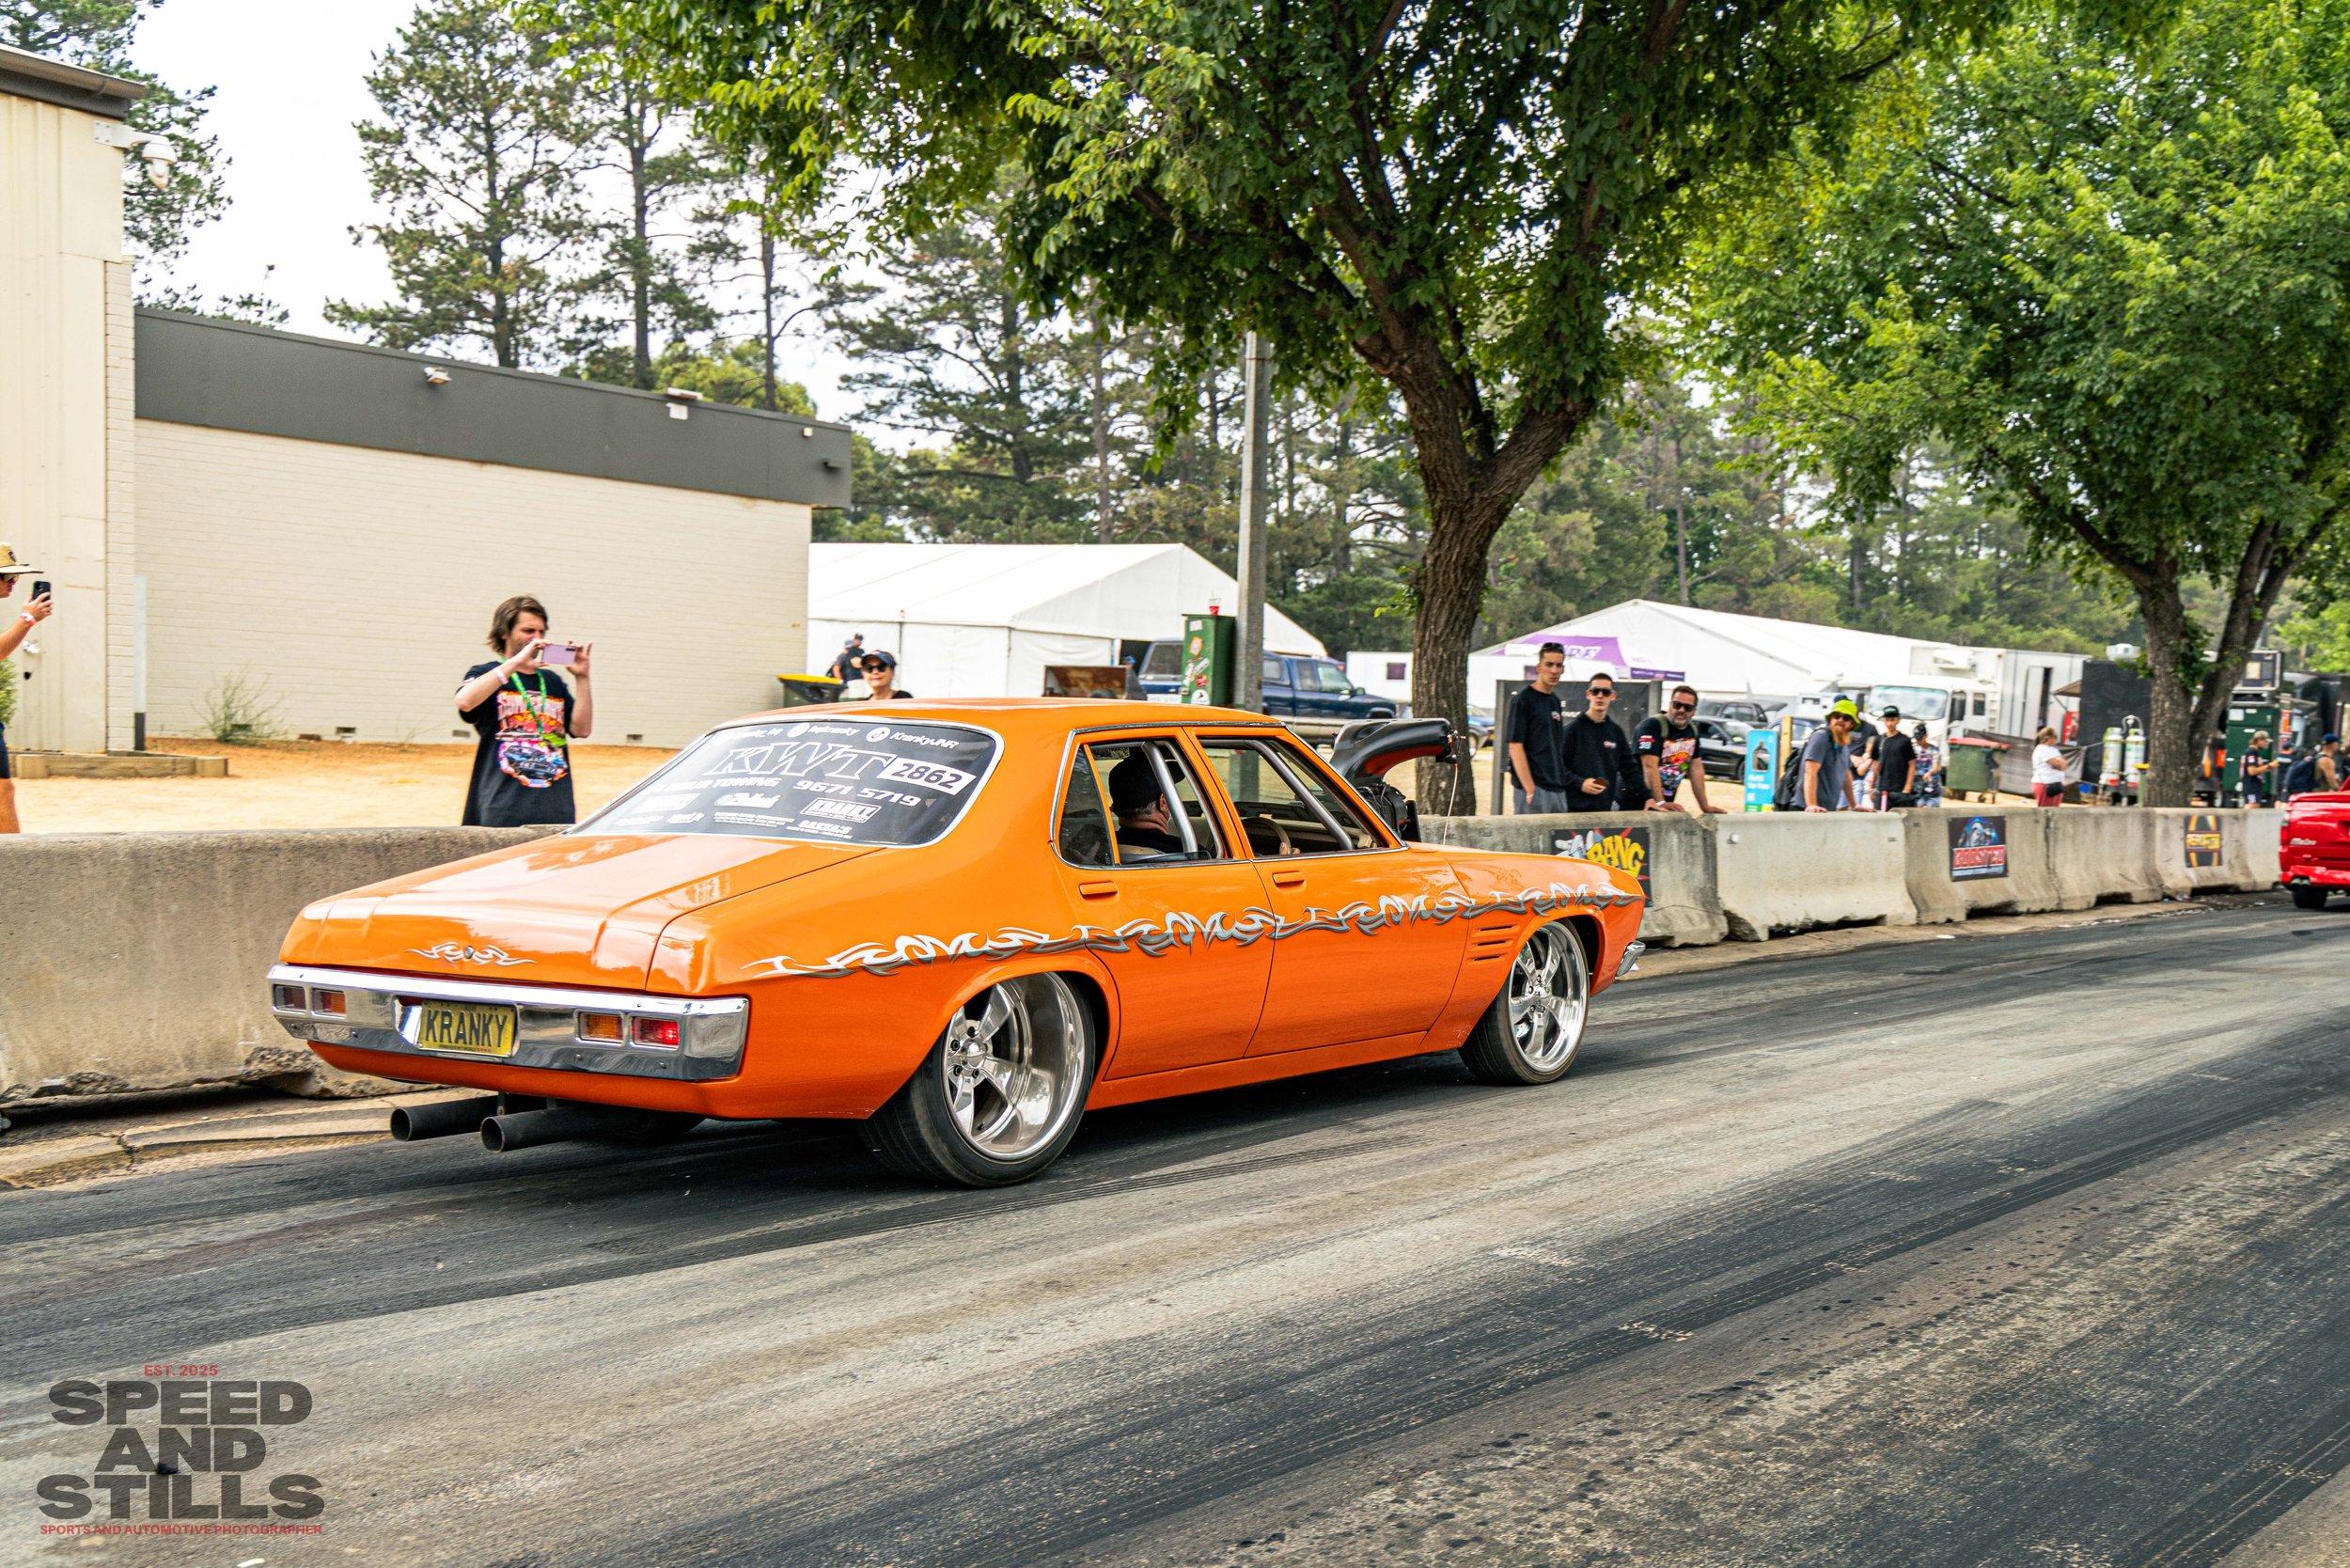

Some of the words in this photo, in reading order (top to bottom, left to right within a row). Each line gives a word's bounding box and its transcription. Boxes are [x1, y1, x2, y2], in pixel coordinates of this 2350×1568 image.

[701, 741, 898, 780] KWT
[891, 761, 964, 789] 2862
[713, 777, 783, 788] TOWING
[793, 779, 854, 796] 9671
[856, 787, 921, 807] 5719
[425, 1009, 509, 1048] KRANKY
